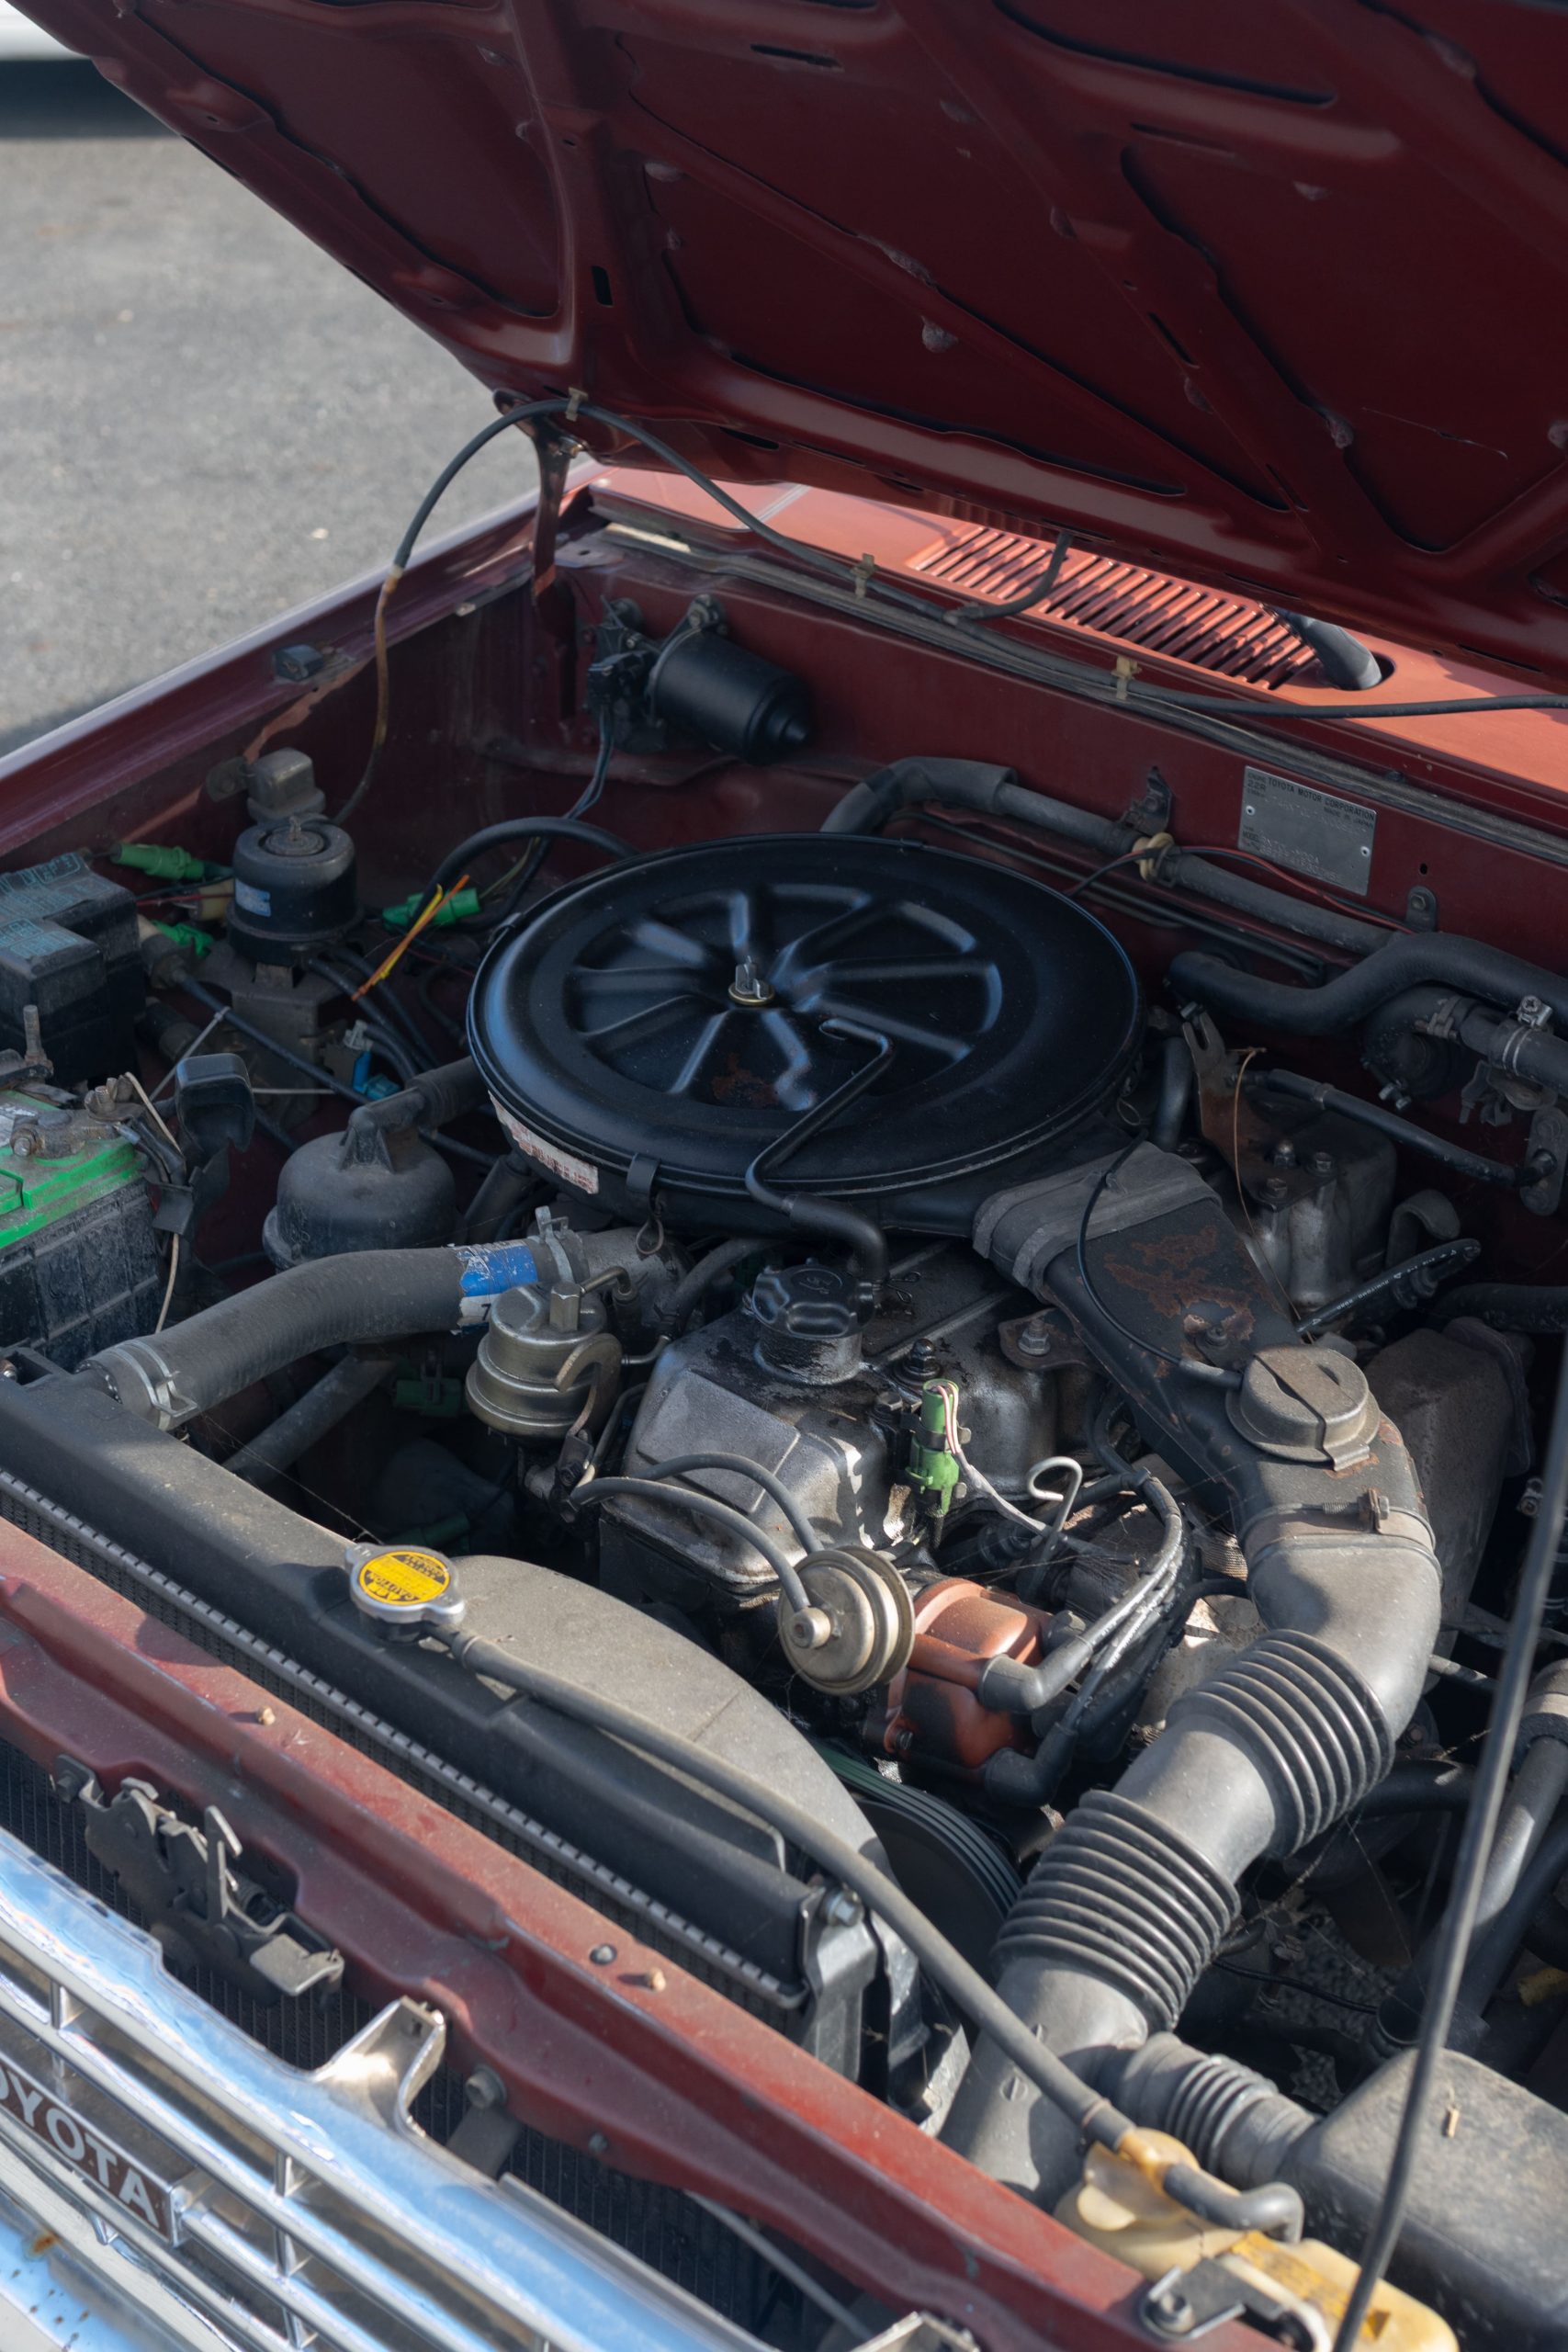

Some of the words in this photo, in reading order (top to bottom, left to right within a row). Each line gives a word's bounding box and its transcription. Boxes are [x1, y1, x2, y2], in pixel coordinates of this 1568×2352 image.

[1269, 777, 1294, 793] TOYOTA
[1298, 788, 1322, 802] MOTOR
[1325, 797, 1374, 820] CORPORATION
[0, 2066, 160, 2228] YOTA
